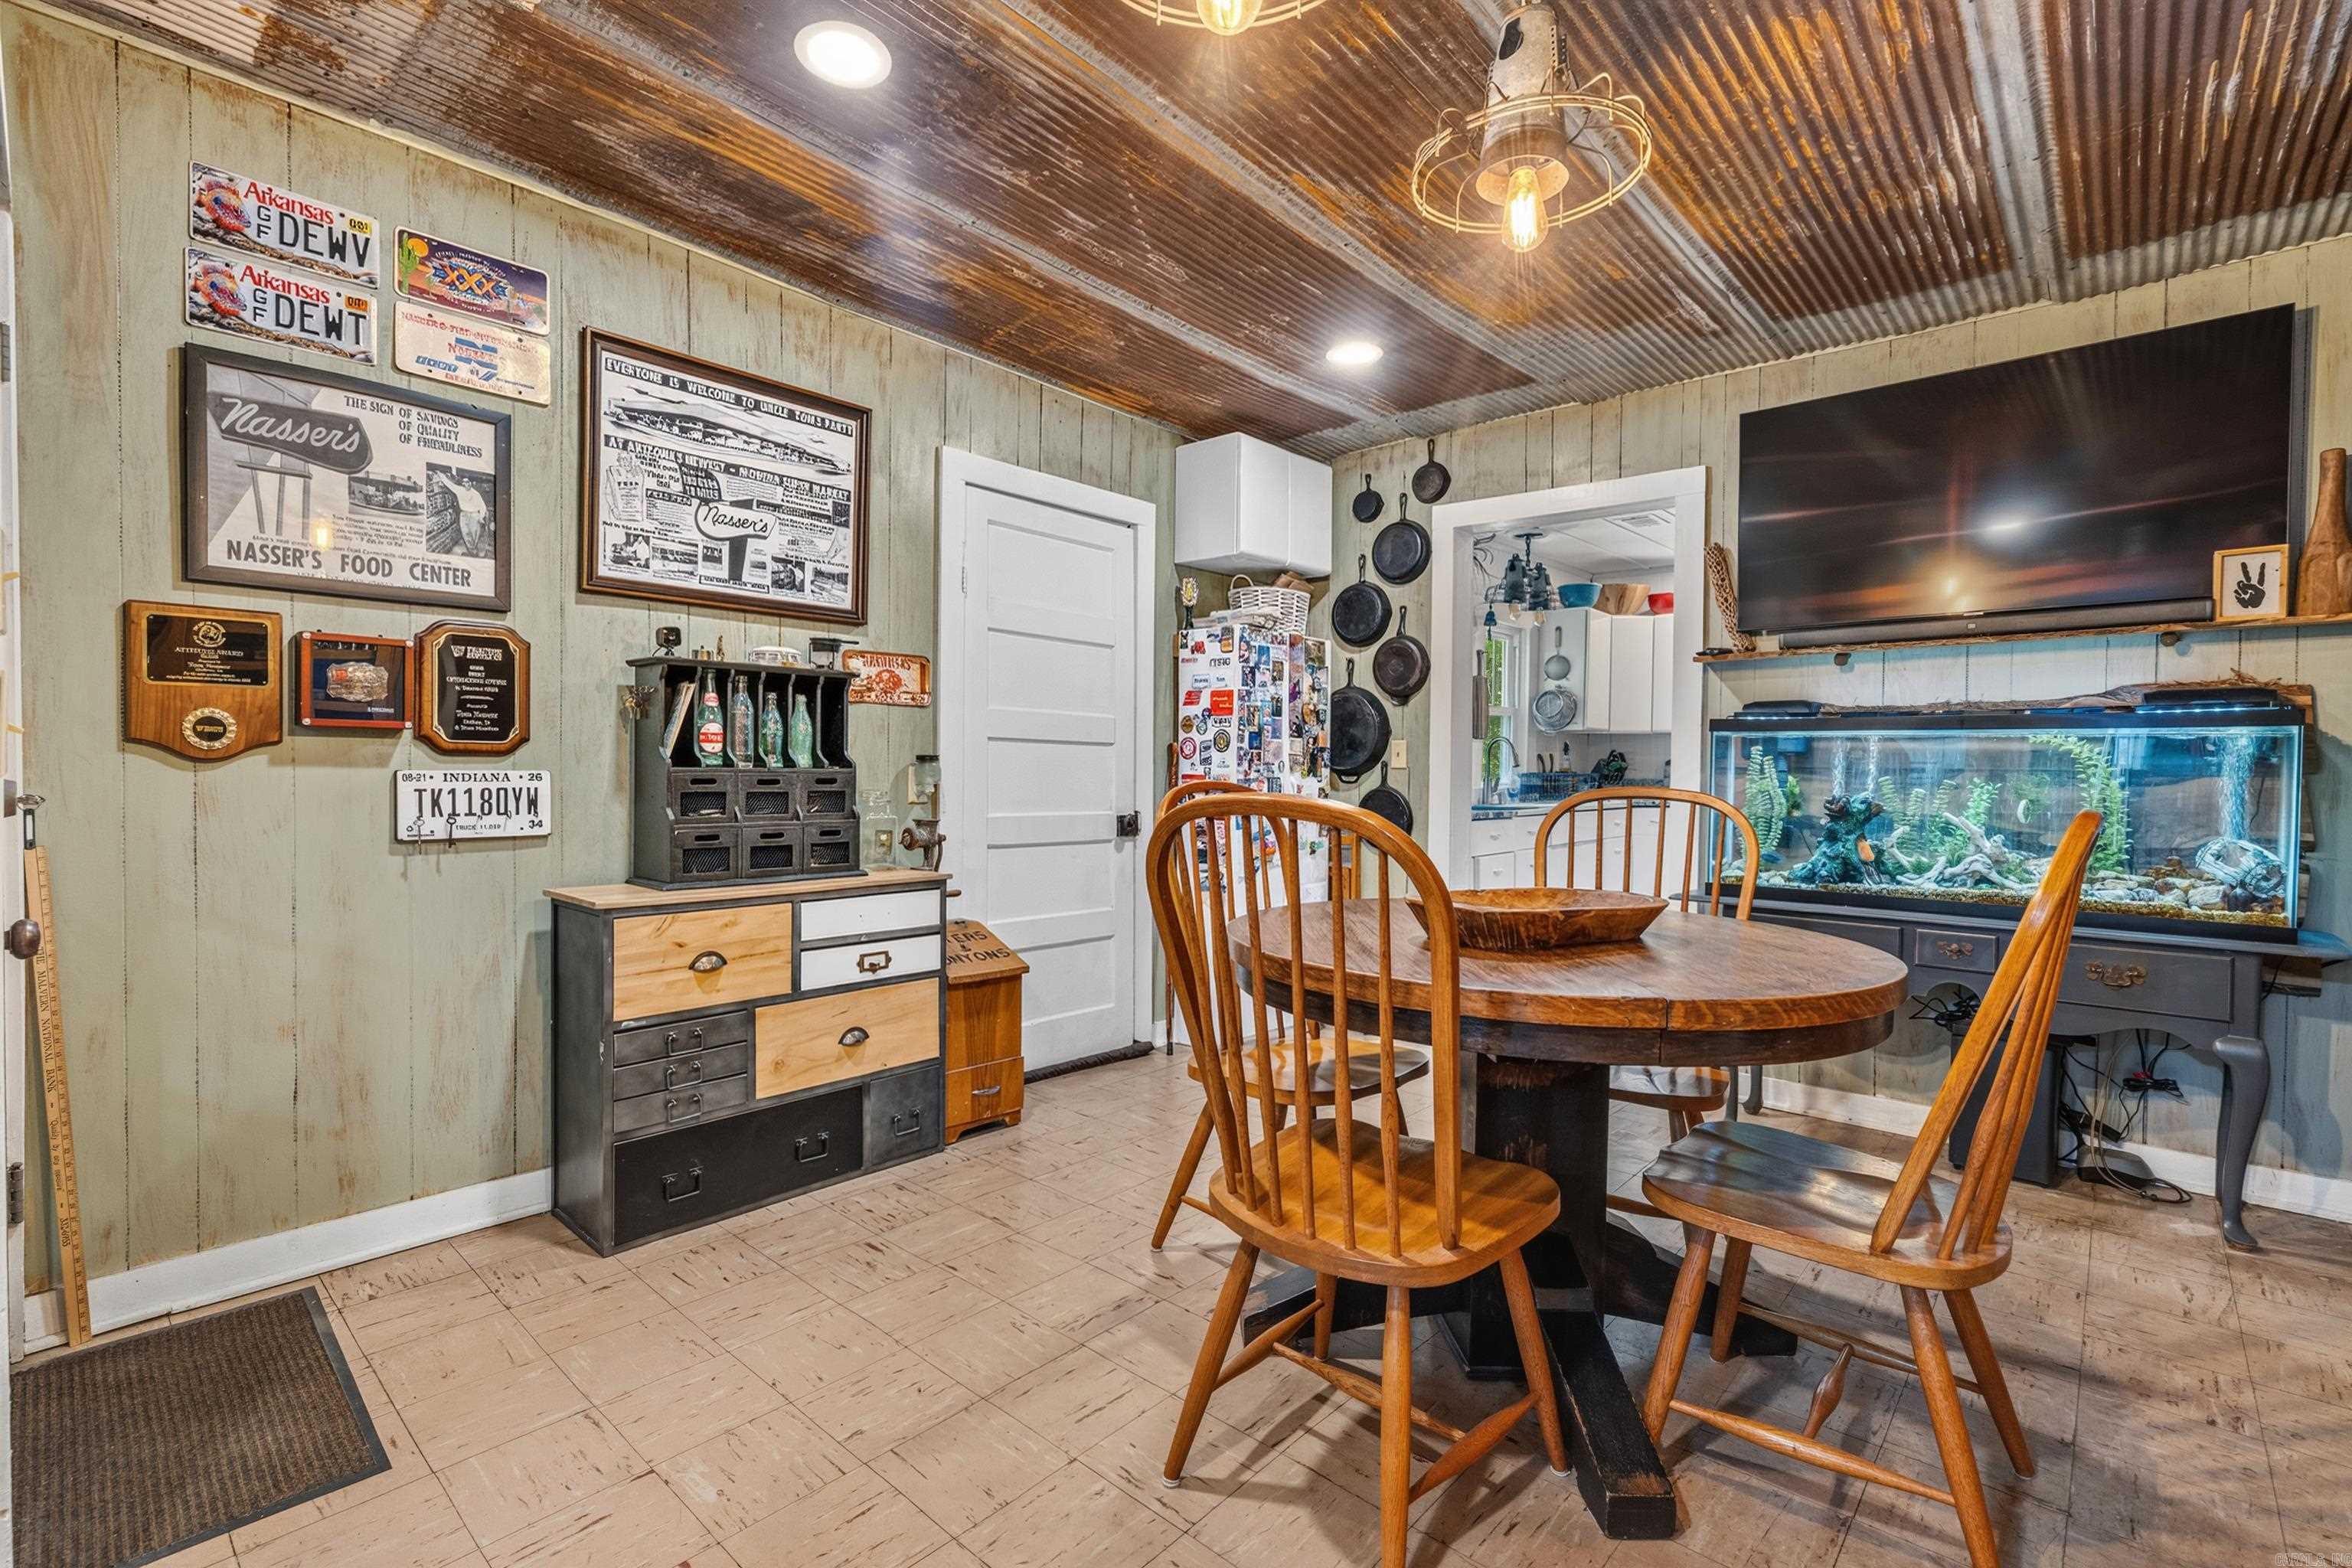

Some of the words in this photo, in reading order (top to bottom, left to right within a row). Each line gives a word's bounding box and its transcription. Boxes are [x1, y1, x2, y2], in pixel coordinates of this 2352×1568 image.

[243, 181, 334, 224] Arkansas
[279, 211, 370, 267] DEWV
[240, 265, 330, 304] Arkansas
[275, 294, 367, 345] DEWT
[606, 358, 662, 384] EVERYONE
[669, 376, 680, 388] IS
[687, 381, 736, 403] WELCOME
[740, 396, 754, 409] TO
[220, 397, 361, 452] Nasser's
[344, 395, 367, 410] THE
[369, 401, 394, 416] SIGN
[399, 407, 412, 420] OF
[399, 420, 412, 431] OF
[416, 424, 459, 442] QUALITY
[399, 433, 413, 444] OF
[703, 505, 768, 533] Nasser's
[227, 539, 322, 570] NASSER'S
[340, 554, 393, 578] FOOD
[409, 562, 472, 587] CENTER
[443, 772, 511, 783] INDIANA
[528, 773, 544, 782] 26
[946, 930, 988, 943] ERS
[37, 970, 49, 1011] MALVERN
[41, 1018, 54, 1063] NATIONAL
[46, 1068, 57, 1093] BANK
